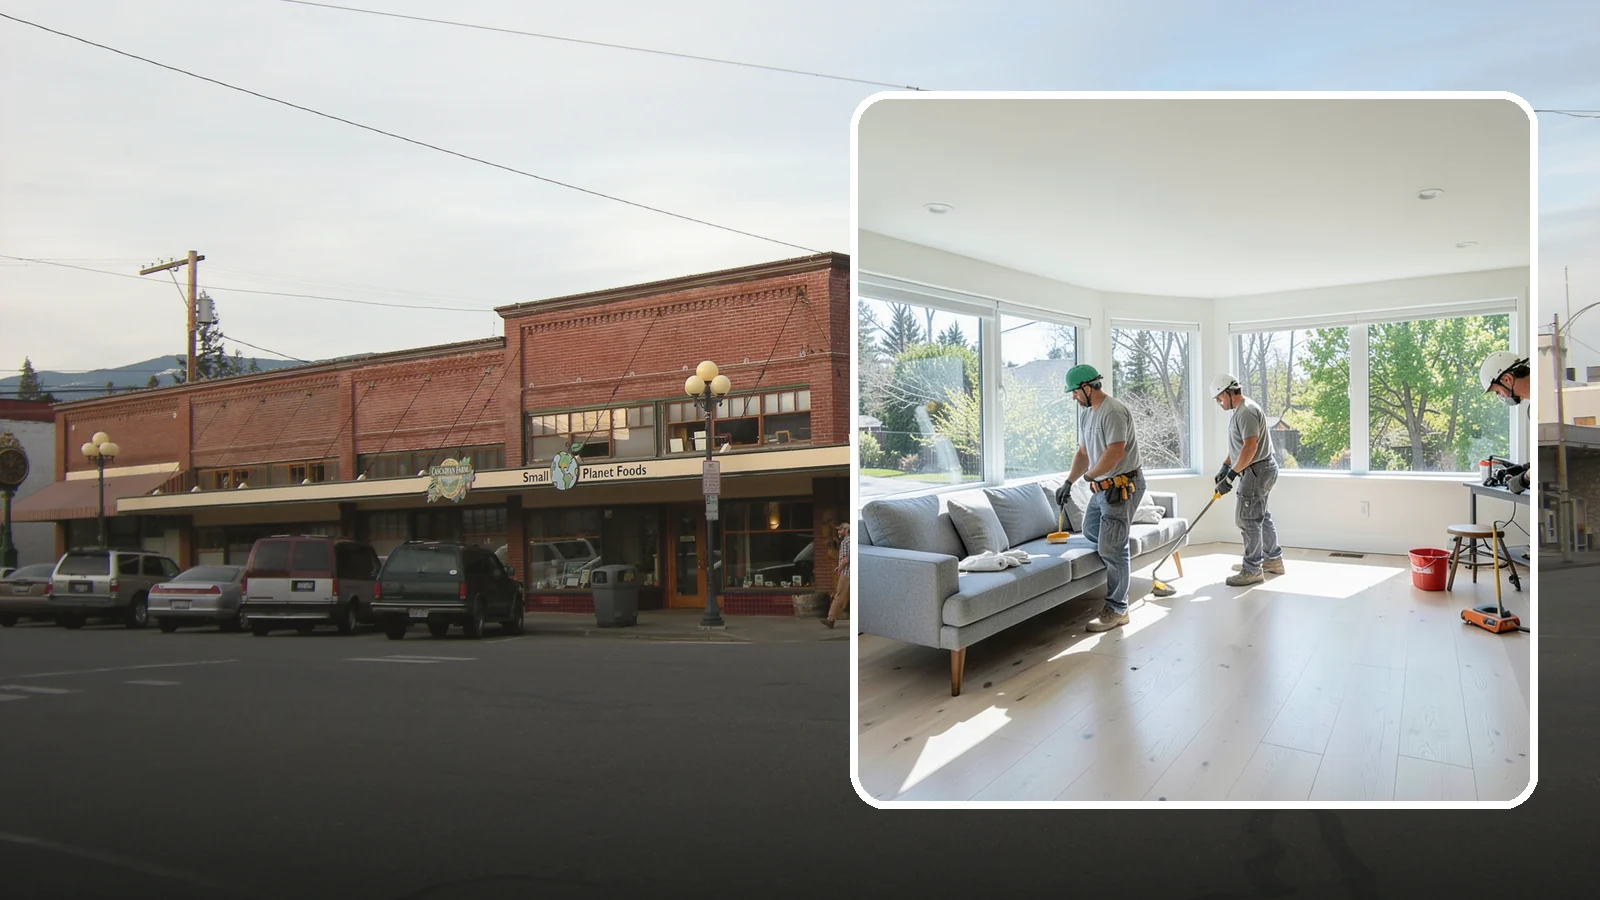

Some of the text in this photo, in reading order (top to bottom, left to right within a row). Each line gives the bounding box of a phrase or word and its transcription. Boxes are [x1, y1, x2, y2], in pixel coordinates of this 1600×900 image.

[523, 464, 647, 483] Small Planet Foods
